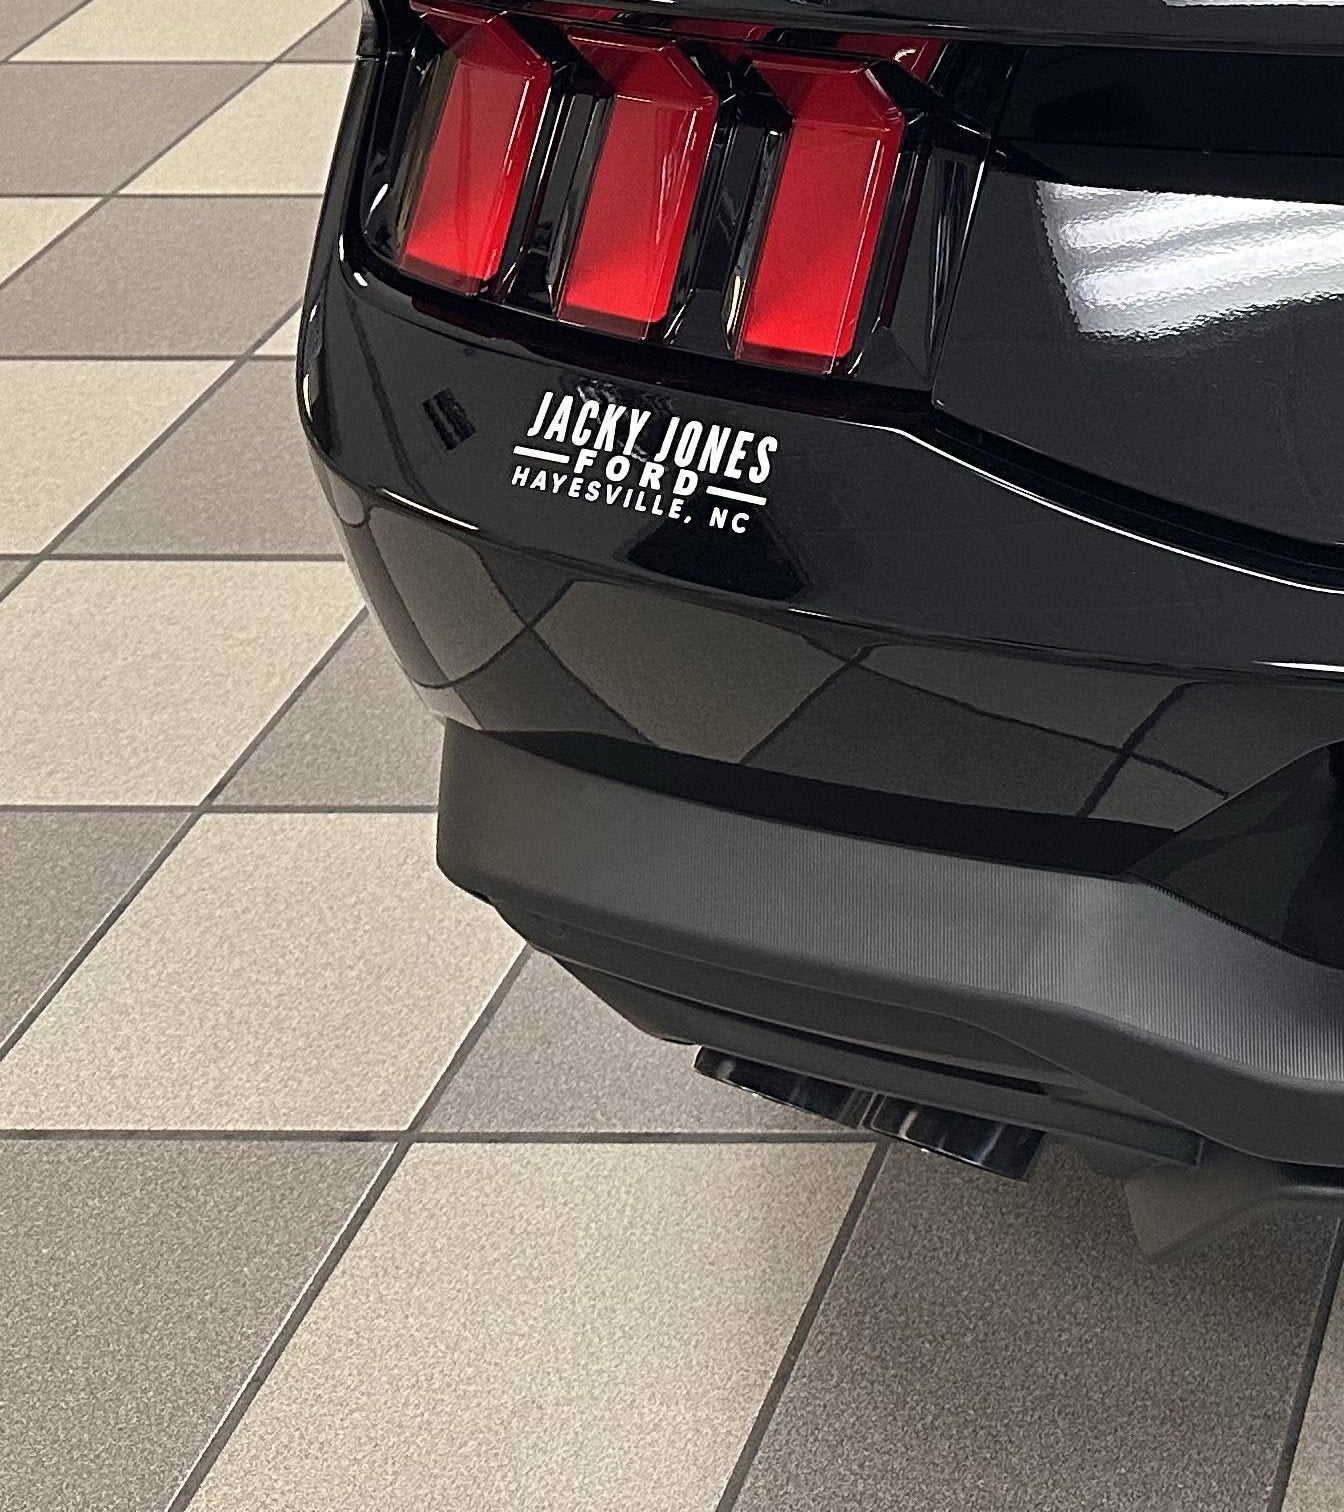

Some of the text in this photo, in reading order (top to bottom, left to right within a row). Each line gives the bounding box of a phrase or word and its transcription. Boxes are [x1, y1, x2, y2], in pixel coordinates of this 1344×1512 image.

[526, 391, 779, 485] JACKY JONES
[573, 447, 699, 497] FORD
[510, 464, 751, 535] HAYESVILLE, NC
